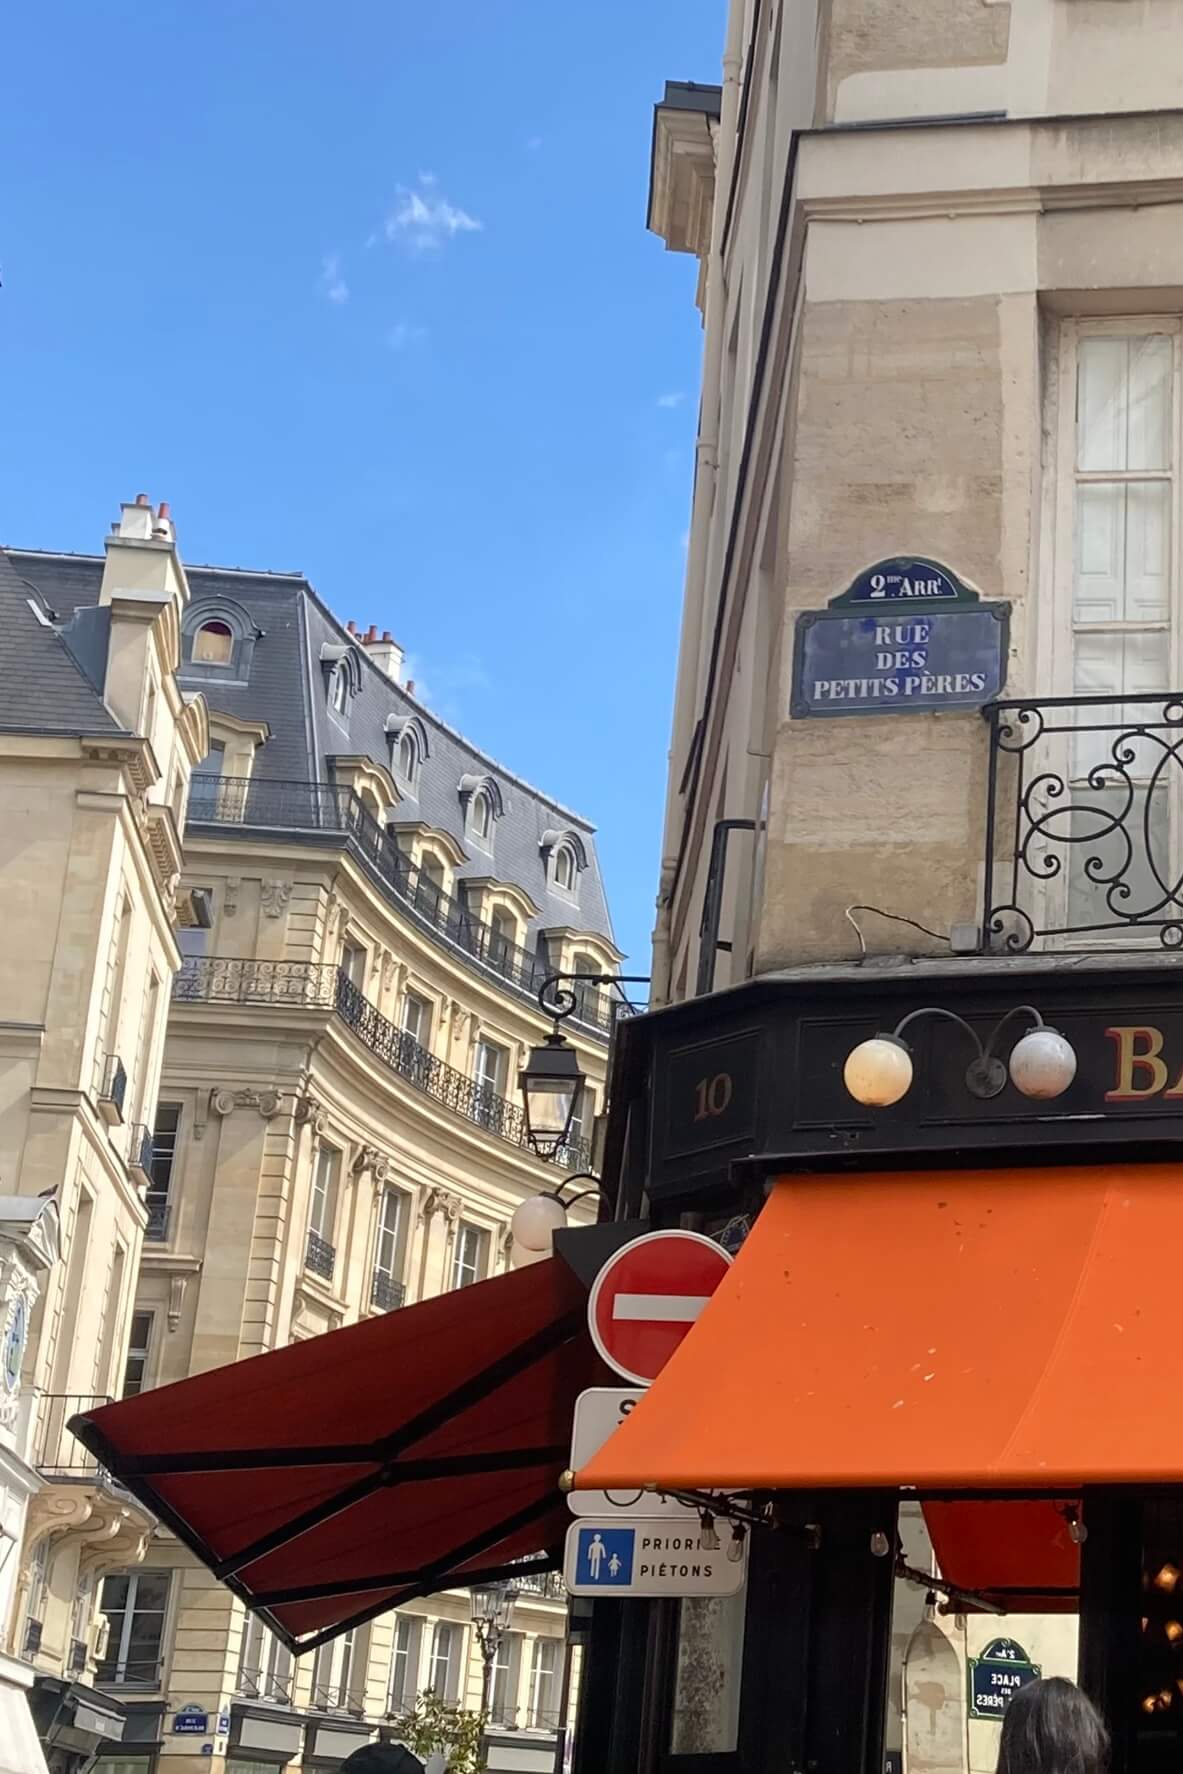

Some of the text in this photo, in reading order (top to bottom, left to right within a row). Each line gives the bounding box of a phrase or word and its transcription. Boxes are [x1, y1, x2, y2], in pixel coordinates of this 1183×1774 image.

[875, 624, 929, 646] RUE
[876, 651, 926, 670] DES
[813, 670, 986, 700] PETITS PÈRES
[693, 1072, 733, 1122] 10
[640, 1562, 713, 1578] PIÉTONS
